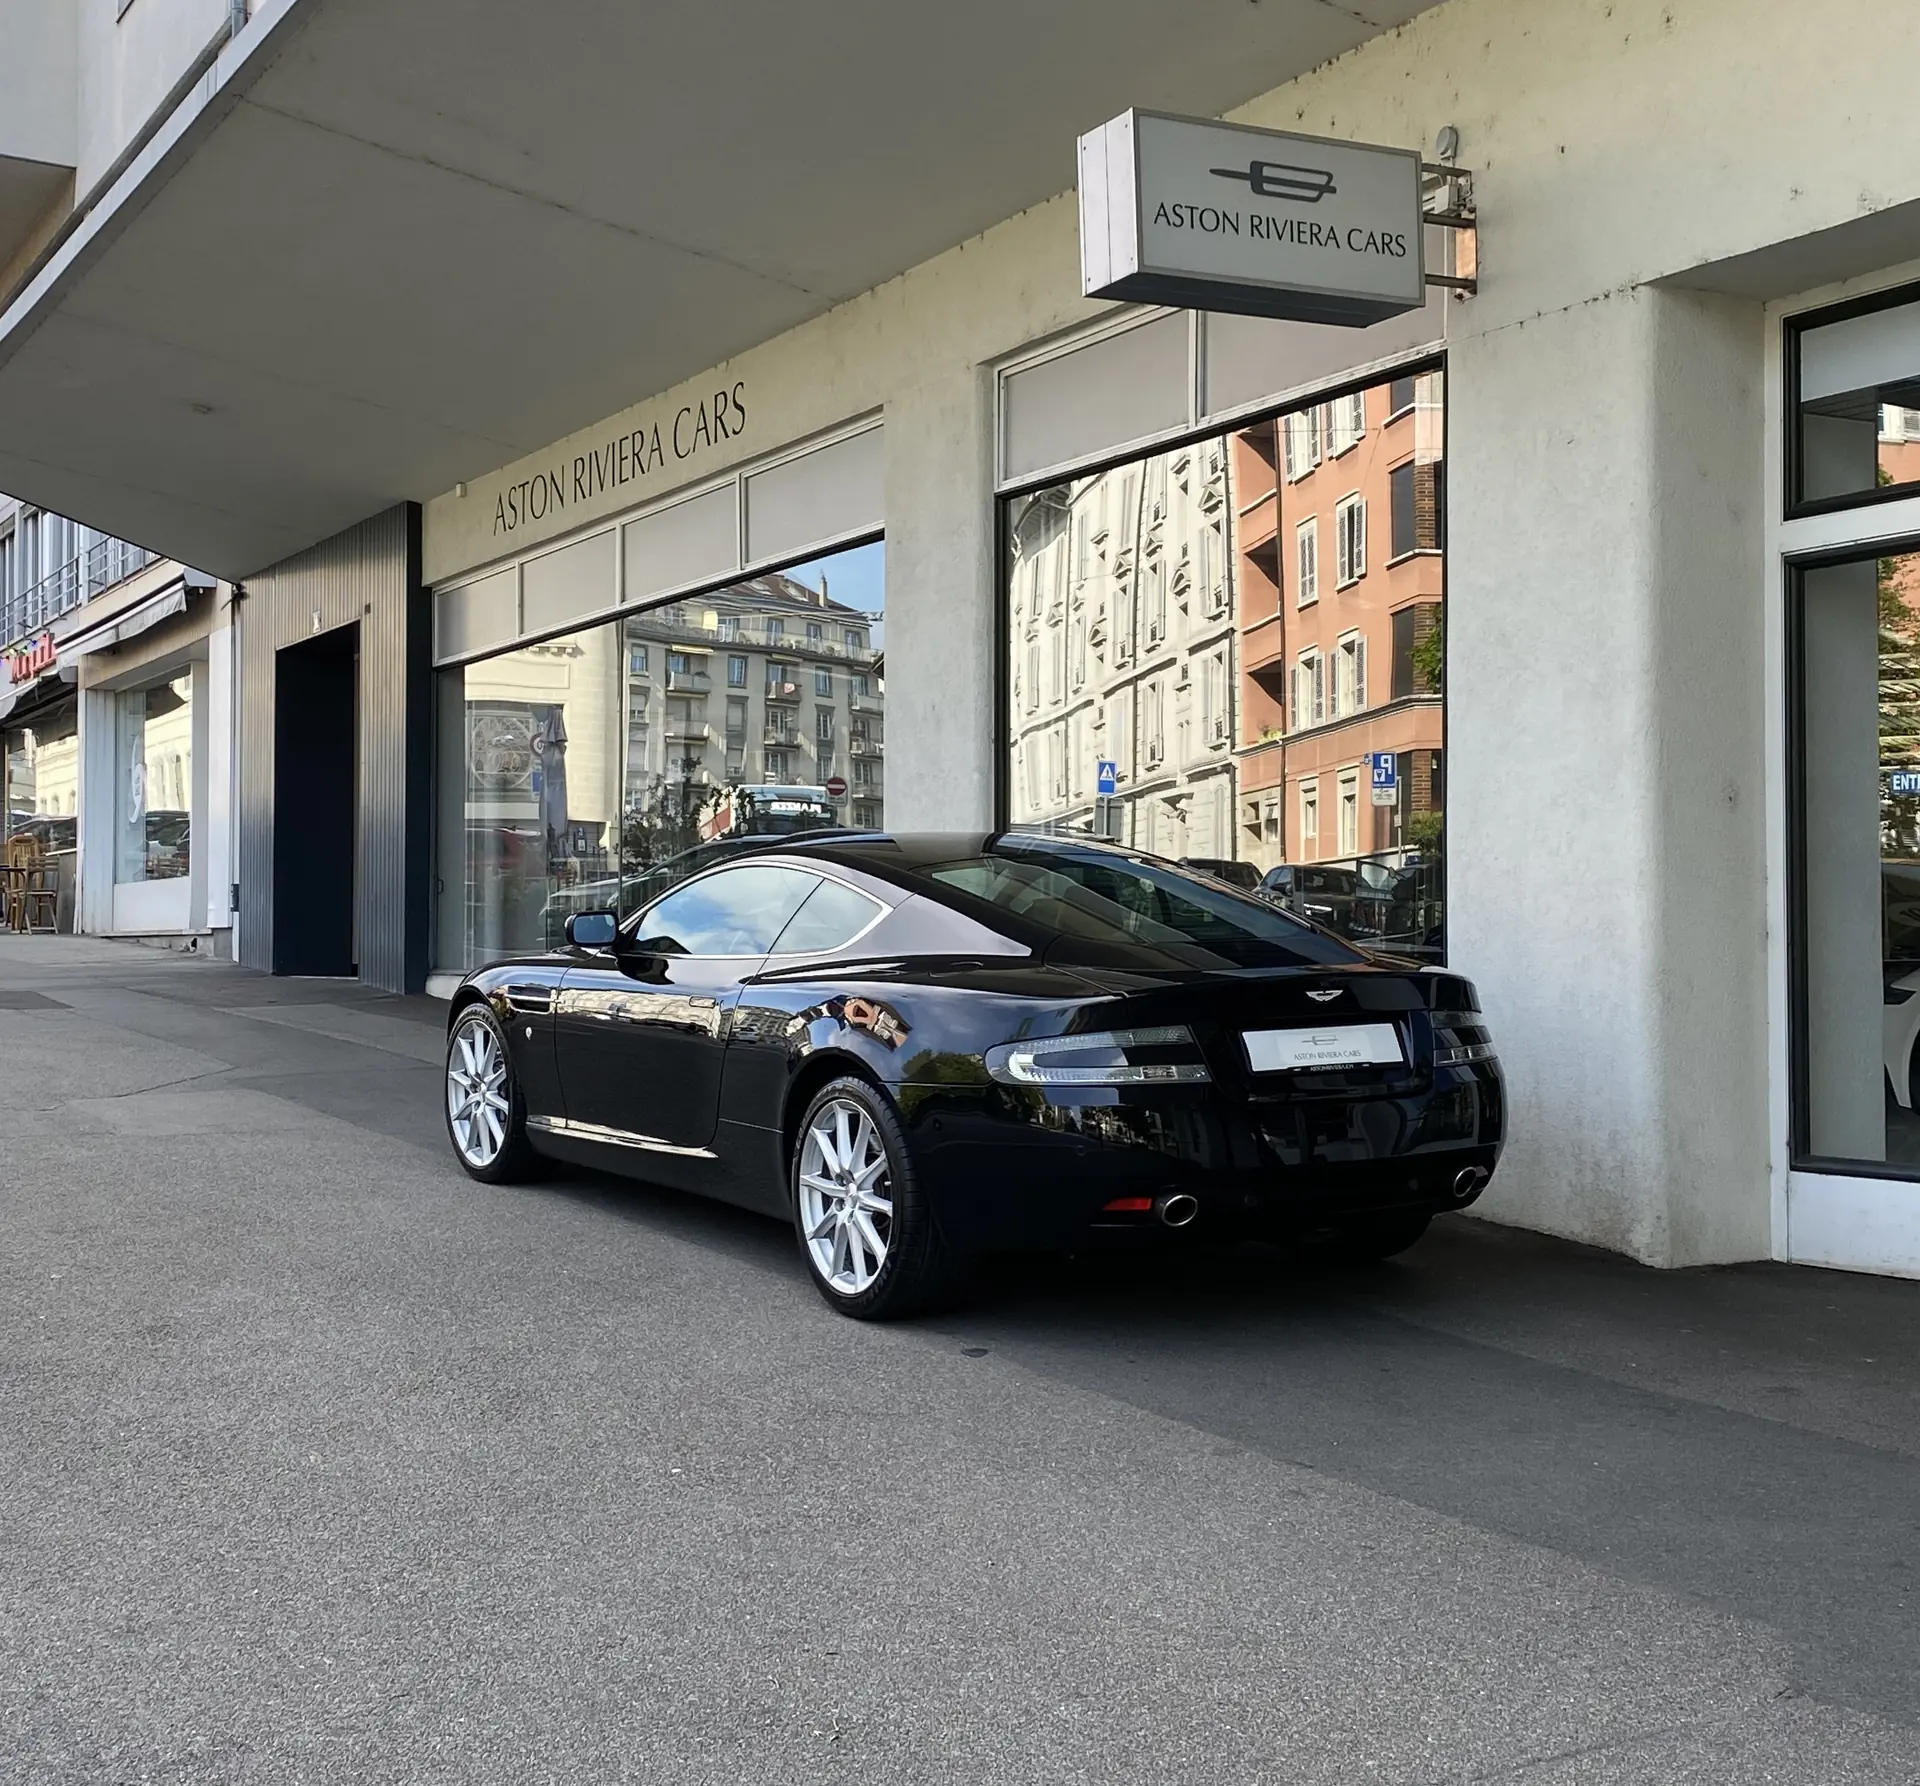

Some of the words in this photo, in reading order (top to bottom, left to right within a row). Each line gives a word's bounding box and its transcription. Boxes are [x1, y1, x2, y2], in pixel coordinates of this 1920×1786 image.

[1153, 201, 1240, 236] ASTON
[1250, 214, 1341, 249] RIVIERA
[1347, 228, 1407, 258] CARS
[493, 465, 565, 536] ASTON
[574, 422, 664, 503] RIVIERA
[673, 381, 746, 459] CARS
[1294, 1052, 1317, 1060] ASTON
[1317, 1050, 1342, 1059] RIVIERA
[1343, 1049, 1361, 1057] CARS
